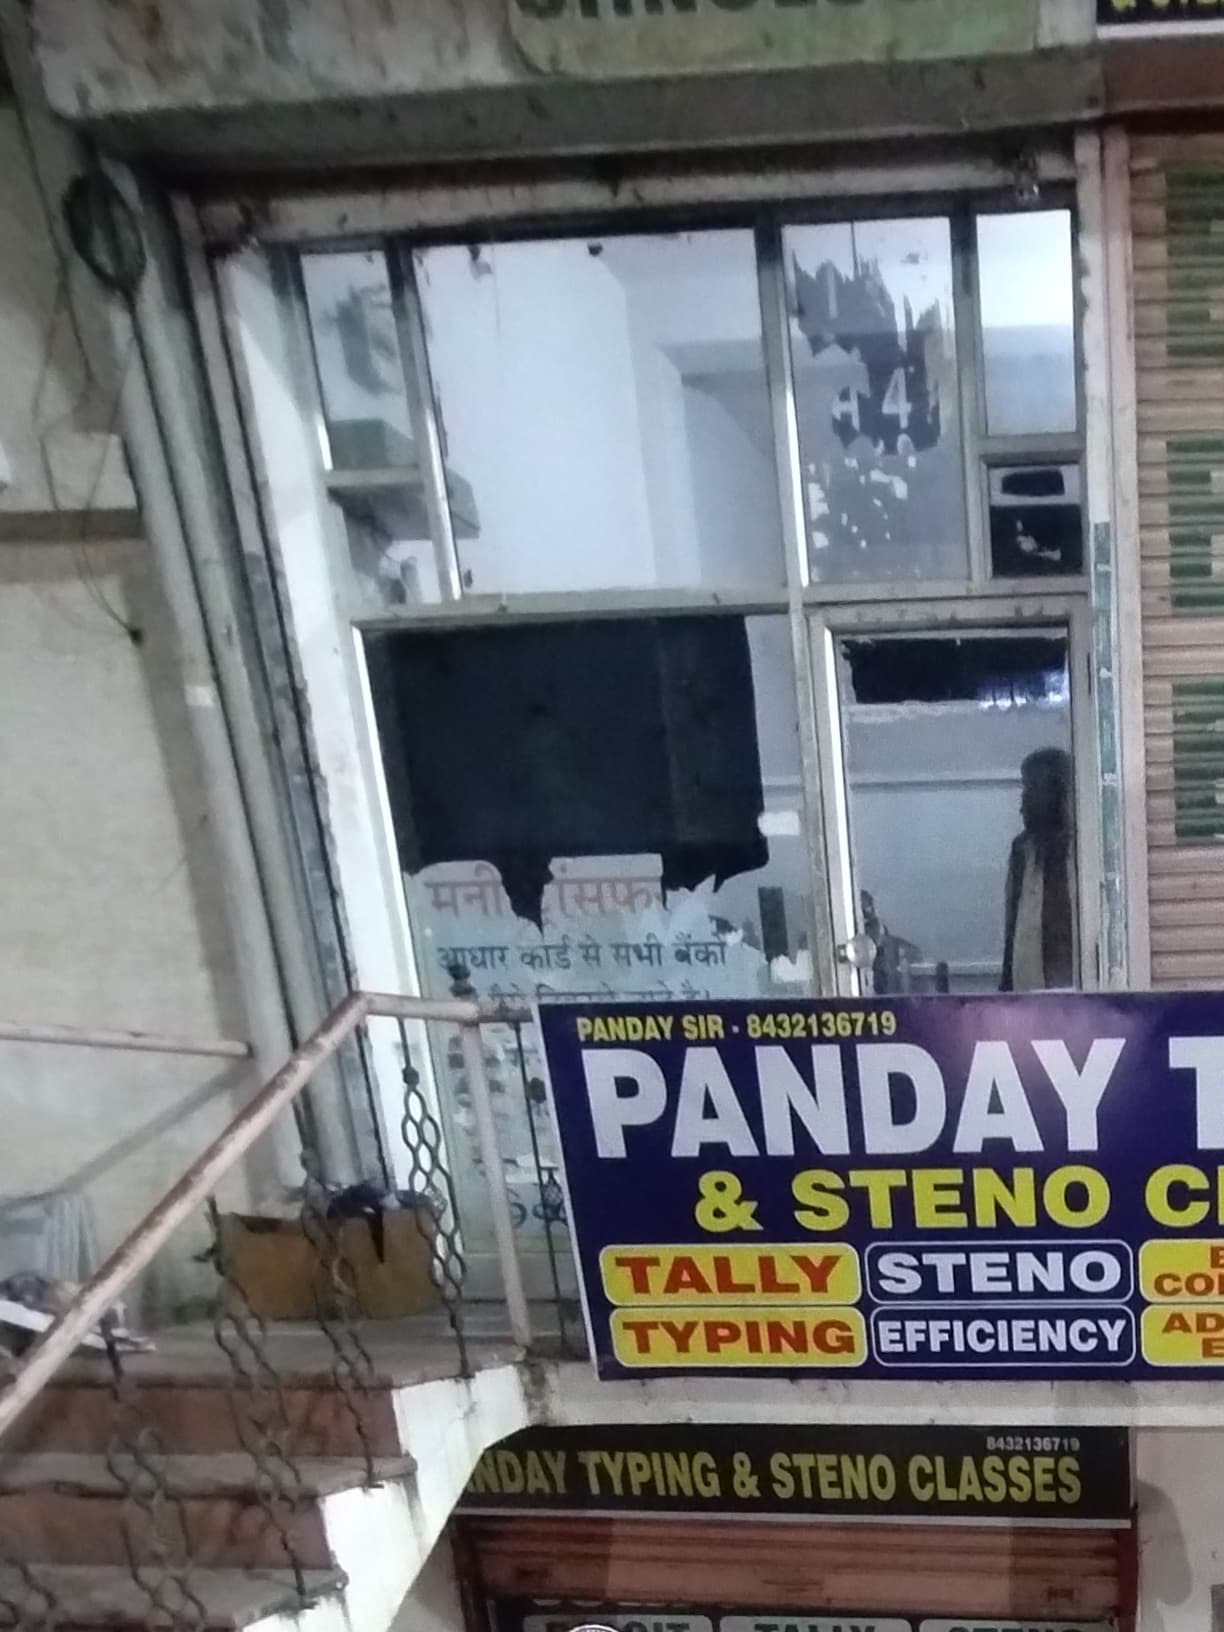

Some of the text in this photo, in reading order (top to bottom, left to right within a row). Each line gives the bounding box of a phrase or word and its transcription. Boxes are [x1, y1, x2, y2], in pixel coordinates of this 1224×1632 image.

[437, 945, 509, 970] आधार
[520, 935, 571, 969] कार्ड
[579, 935, 600, 966] से
[611, 933, 663, 965] सभी
[578, 1017, 672, 1043] PANDAY
[683, 1015, 724, 1041] SIR
[747, 1012, 896, 1039] 8432136719
[581, 1040, 1126, 1158] PANDAY
[695, 1170, 763, 1233] &
[792, 1165, 1111, 1230] STENO
[615, 1255, 842, 1295] TALLY
[878, 1251, 1122, 1294] STENO
[623, 1320, 856, 1355] TYPING
[879, 1319, 1127, 1353] EFFICIENCY
[468, 1450, 1082, 1504] NDAY TYPING & STENO CLASSES
